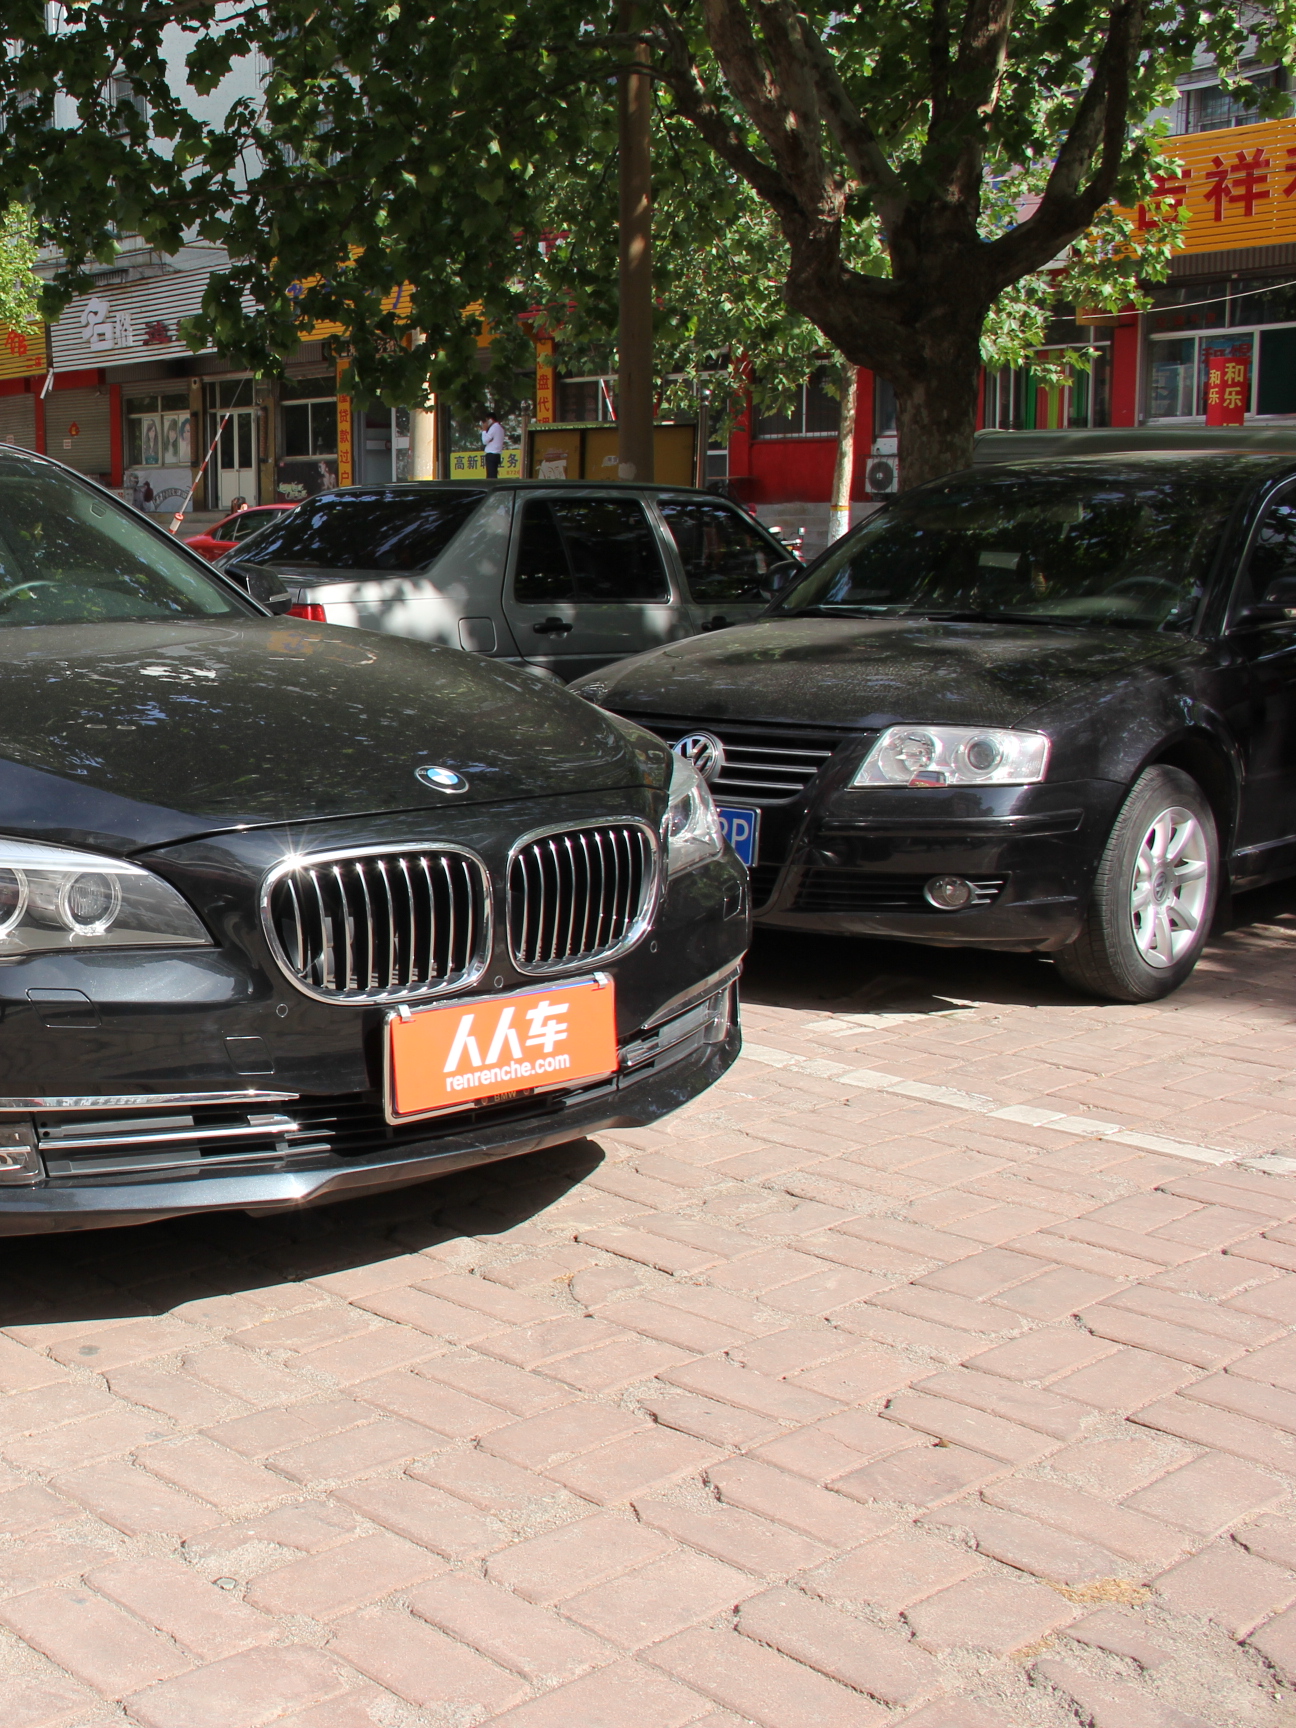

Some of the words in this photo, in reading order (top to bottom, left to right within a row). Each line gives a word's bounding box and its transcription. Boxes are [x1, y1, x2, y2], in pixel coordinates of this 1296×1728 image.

[1138, 147, 1296, 231] 吉祥
[1208, 369, 1221, 405] 和乐
[1222, 362, 1244, 426] 和乐
[443, 1000, 570, 1073] 人人车
[445, 1053, 571, 1092] renrenche.com
